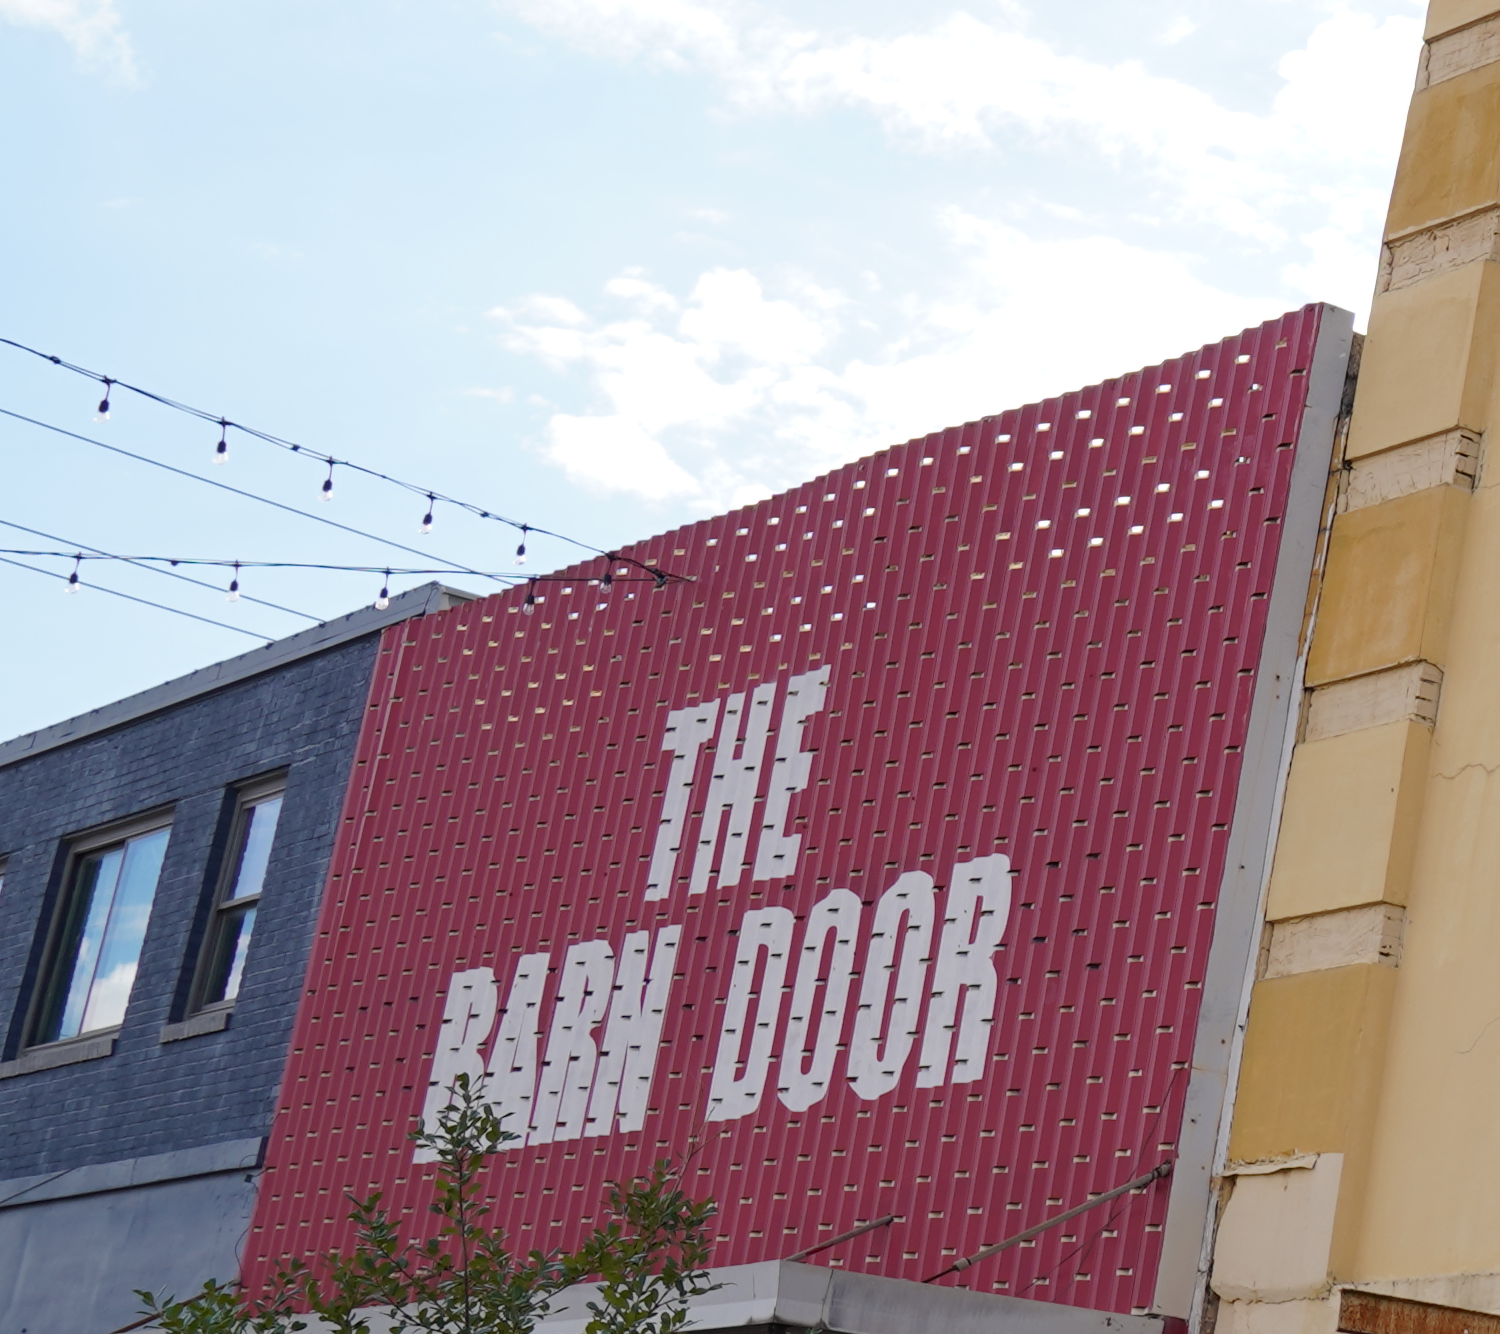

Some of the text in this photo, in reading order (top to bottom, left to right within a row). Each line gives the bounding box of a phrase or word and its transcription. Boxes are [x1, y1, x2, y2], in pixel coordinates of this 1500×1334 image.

[644, 664, 832, 902] THE
[412, 852, 1013, 1166] BARN DOOR
